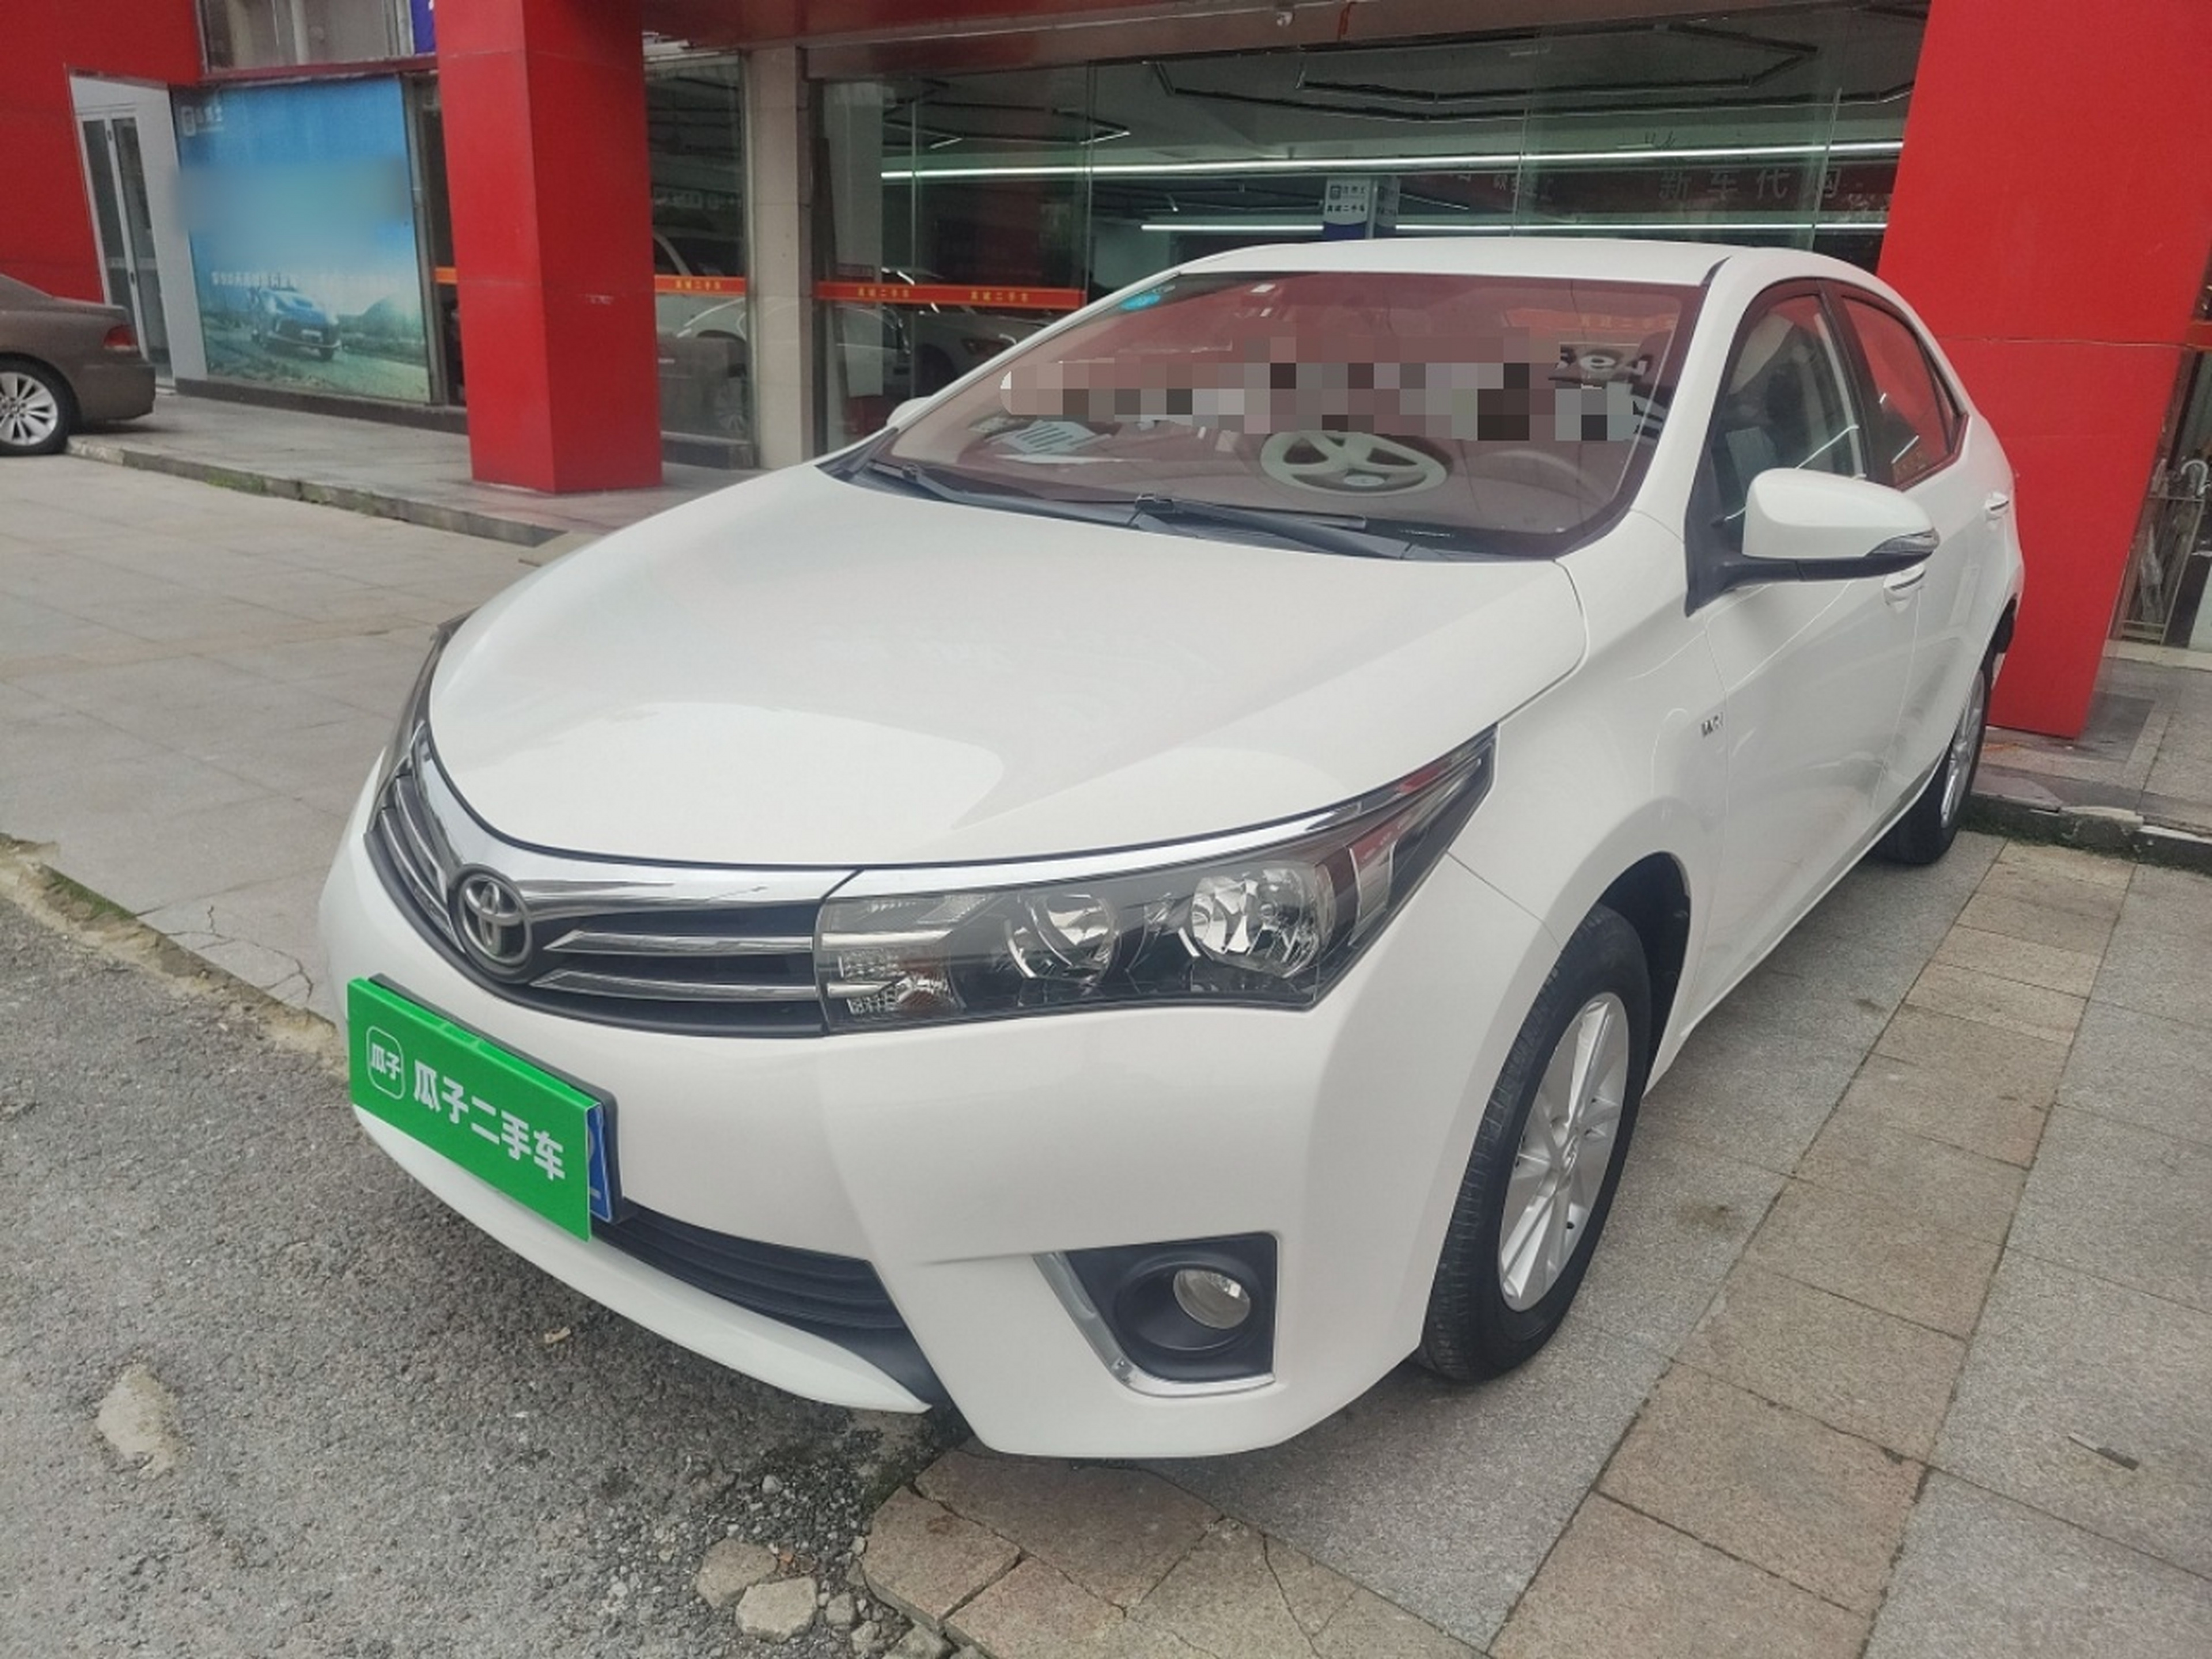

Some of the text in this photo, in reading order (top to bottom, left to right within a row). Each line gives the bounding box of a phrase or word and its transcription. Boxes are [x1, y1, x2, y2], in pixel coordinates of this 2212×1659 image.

[371, 1043, 401, 1081] 瓜子
[414, 1059, 566, 1181] 瓜子二手车
